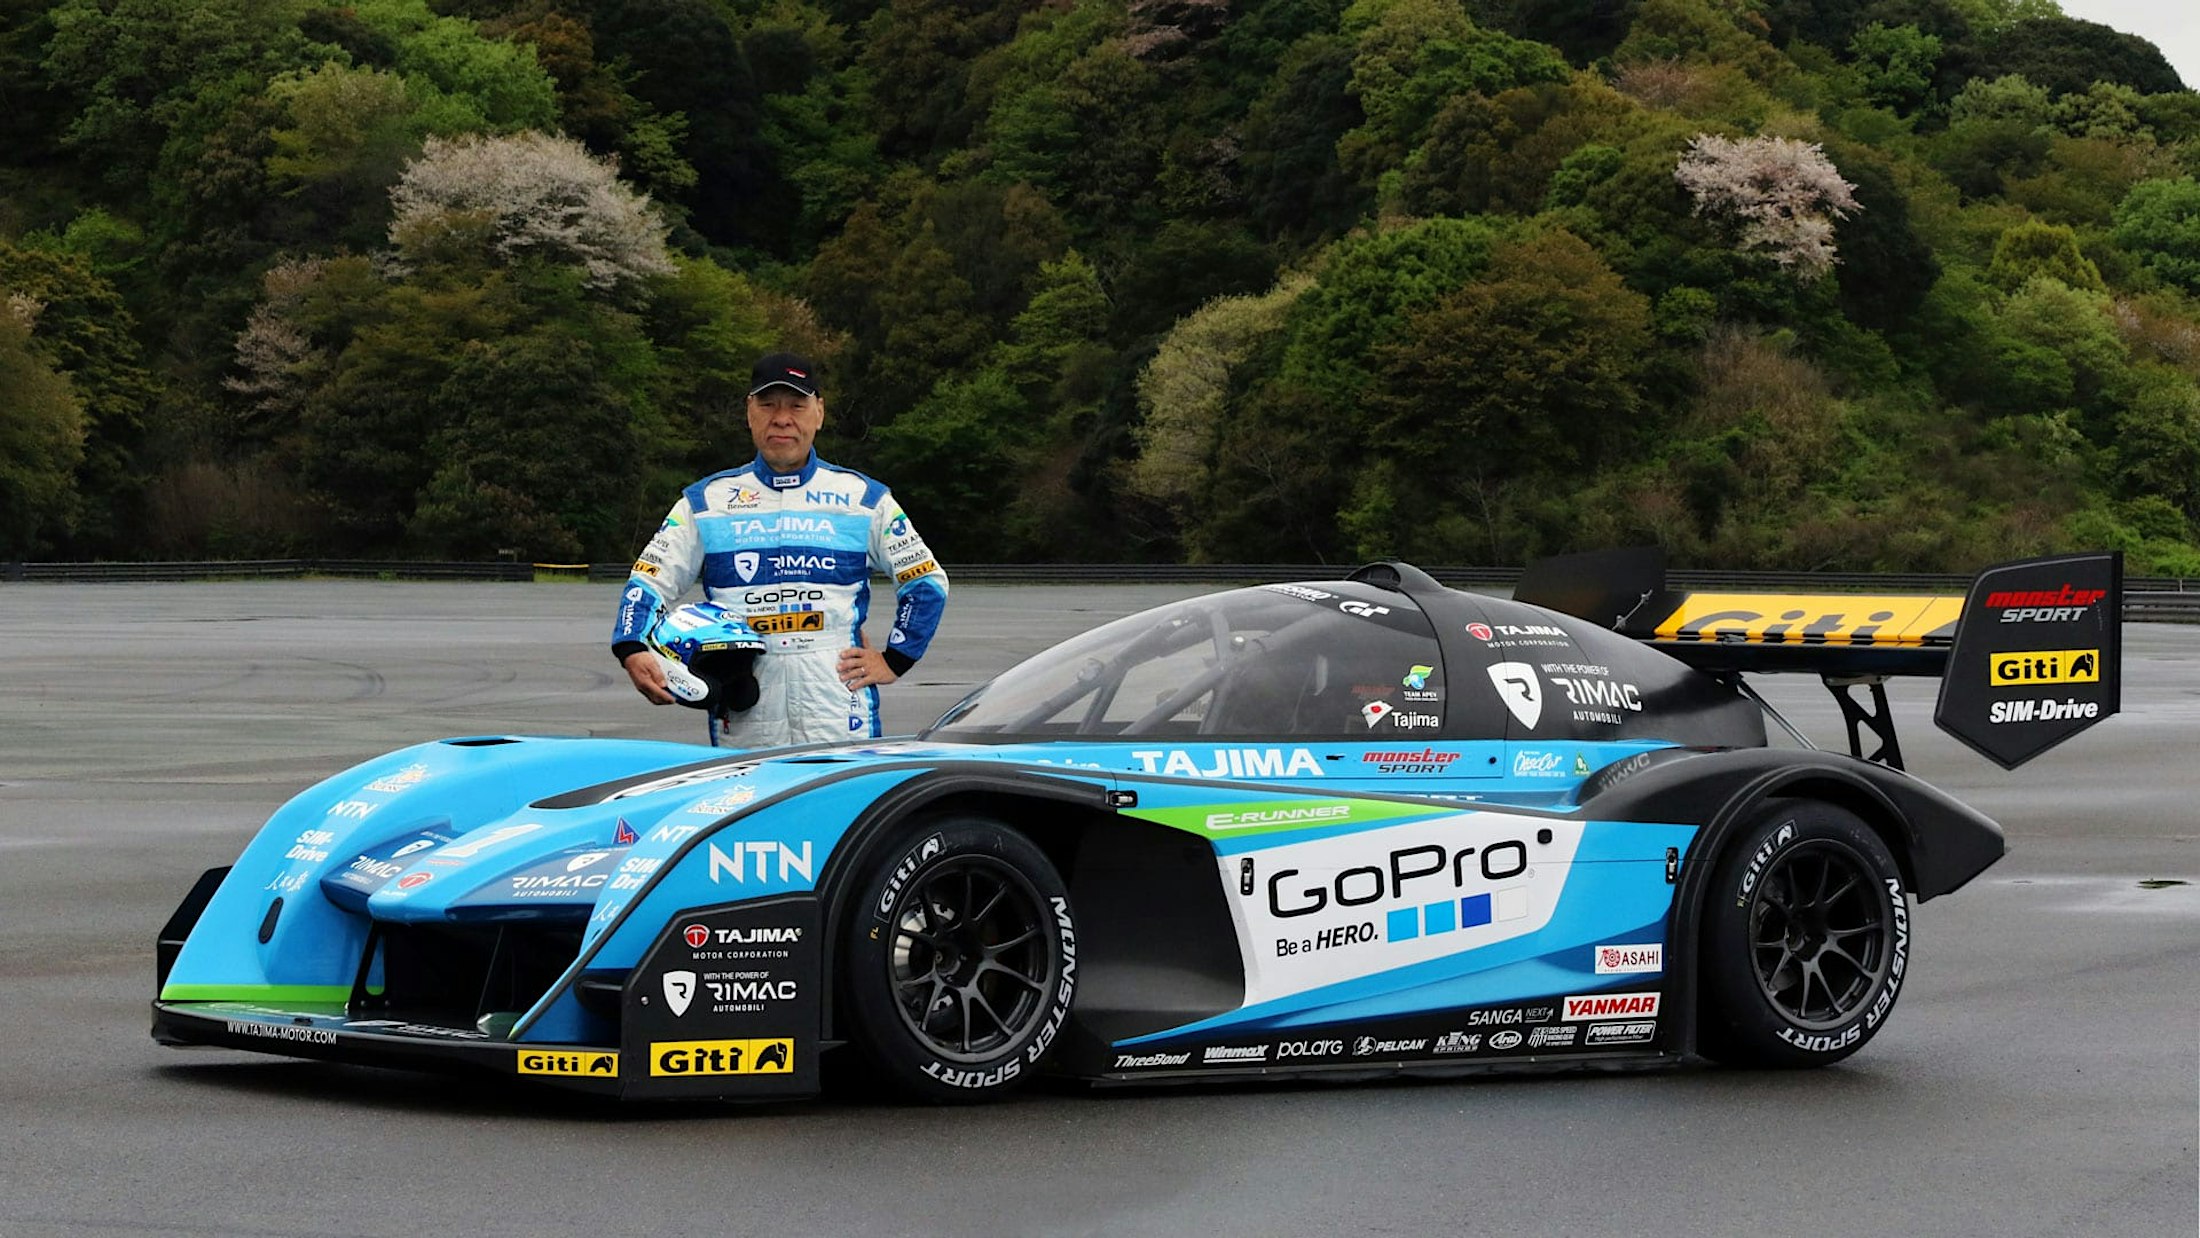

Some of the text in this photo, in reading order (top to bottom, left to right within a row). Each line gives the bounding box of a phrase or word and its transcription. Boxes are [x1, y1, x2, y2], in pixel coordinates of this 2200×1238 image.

[806, 490, 850, 506] NTN
[731, 517, 836, 535] TAJIMA
[767, 556, 837, 569] RIMAC
[745, 589, 823, 604] GoPro
[1985, 584, 2107, 608] monster
[2000, 607, 2087, 623] SPORT
[753, 617, 793, 631] Giti
[1494, 626, 1568, 637] TAJIMA
[1487, 640, 1515, 648] MOTOR
[1541, 664, 1562, 675] WITH
[1998, 657, 2058, 680] Giti
[1550, 678, 1642, 712] RIMAC
[1573, 711, 1622, 725] AUTOMOBILI
[1989, 698, 2099, 724] SIM-Drive
[1391, 711, 1439, 729] Tajima
[1132, 748, 1325, 778] TAJIMA
[1362, 748, 1462, 763] monster
[1377, 764, 1450, 774] SPORT
[327, 800, 378, 819] NTN
[1205, 805, 1350, 830] E-RUNNER
[284, 844, 330, 863] Drive
[350, 855, 402, 878] RIMAC
[709, 841, 813, 885] NTN
[1742, 841, 1774, 894] Giti
[512, 873, 609, 889] RIMAC
[609, 873, 647, 890] Dri
[880, 856, 916, 913] Giti
[1268, 840, 1527, 918] GoPro
[512, 890, 578, 898] AUTOMOBILI
[714, 928, 798, 944] TAJIMA
[1276, 921, 1379, 957] Be a HERO.
[692, 951, 789, 960] MOTOR CORPORATION
[1621, 950, 1659, 966] ASAHI
[1776, 878, 1909, 1052] MONSTER SPORT
[703, 972, 720, 981] WITH
[722, 972, 735, 980] THE
[734, 972, 760, 980] POWER
[705, 981, 797, 1001] RIMAC
[920, 896, 1076, 1089] MONSTER SPORT
[712, 1004, 765, 1013] AUTOMOBILI
[1525, 1008, 1547, 1017] NEXT
[1568, 997, 1656, 1016] YANMAR
[1467, 1009, 1523, 1026] SANGA
[1496, 1032, 1518, 1044] Arai
[1589, 1024, 1653, 1036] POWER FILTER
[1375, 1040, 1425, 1052] PELICAN
[1436, 1031, 1482, 1047] KING
[523, 1055, 580, 1073] Giti
[659, 1047, 743, 1073] Giti
[1114, 1052, 1191, 1068] ThreeBond
